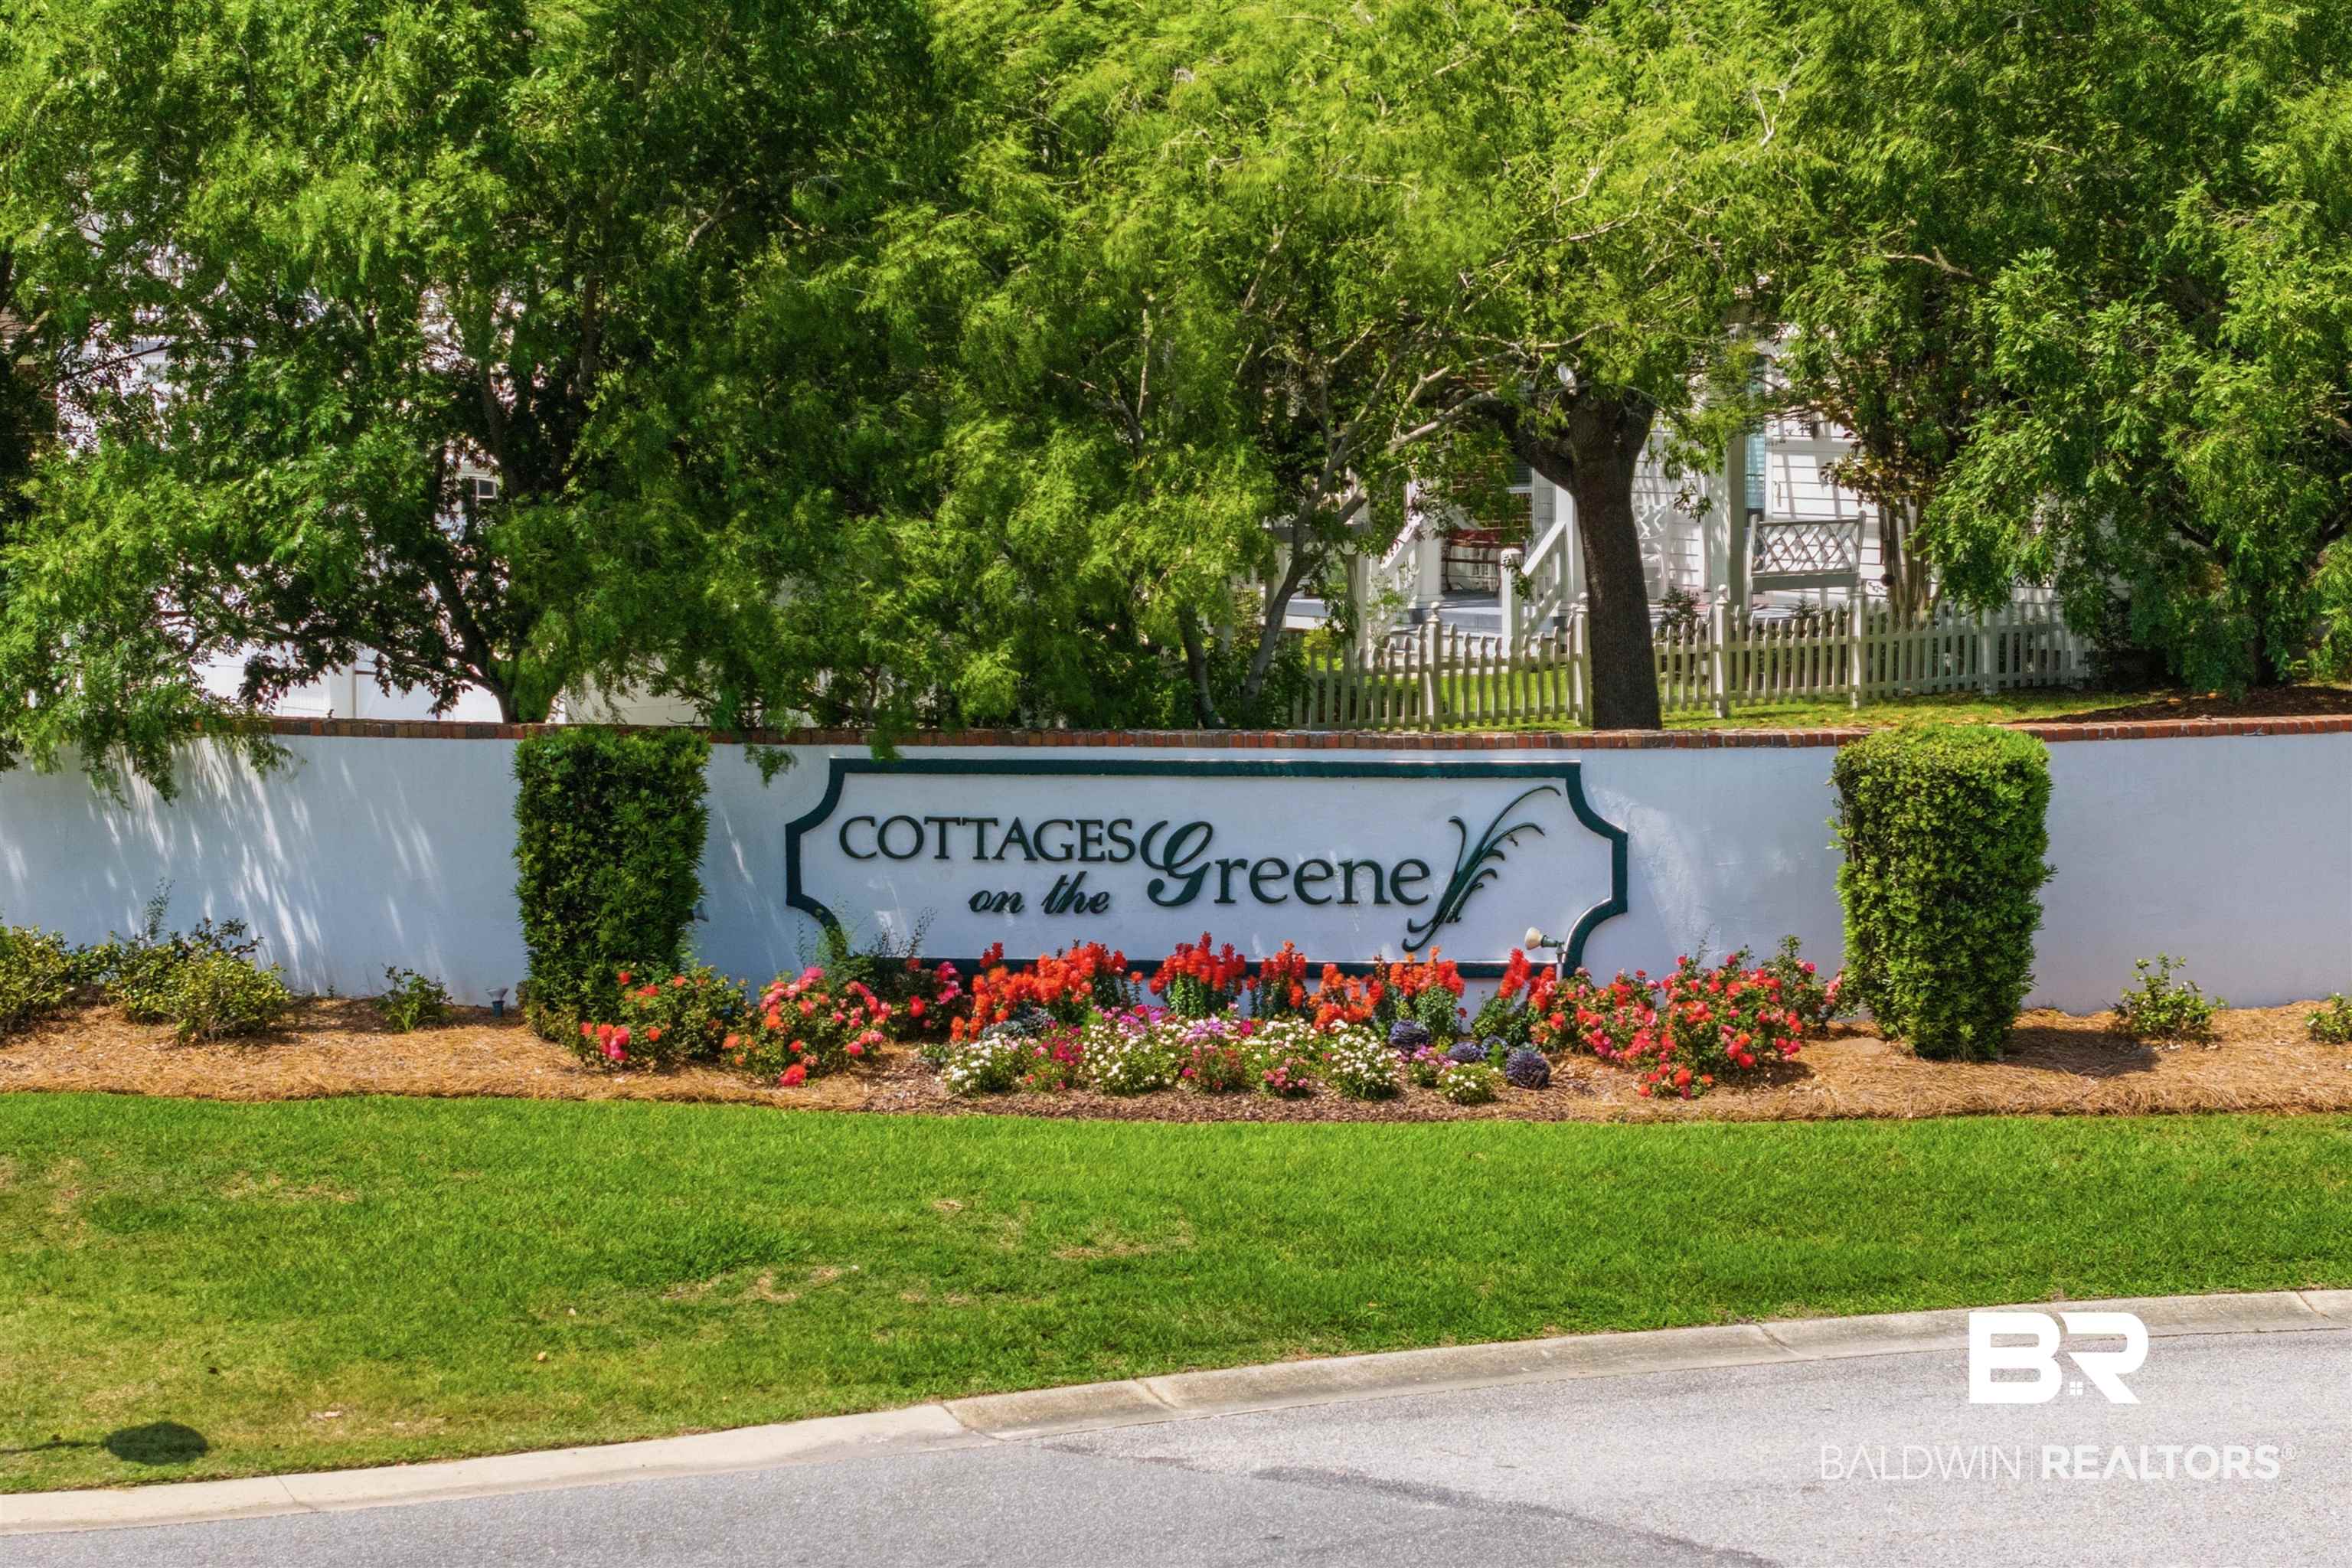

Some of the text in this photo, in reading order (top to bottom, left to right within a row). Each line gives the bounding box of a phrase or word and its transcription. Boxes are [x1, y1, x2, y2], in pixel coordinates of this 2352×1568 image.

[839, 815, 1136, 863] COTTAGES
[1141, 820, 1430, 908] Greene
[968, 871, 1109, 916] on the
